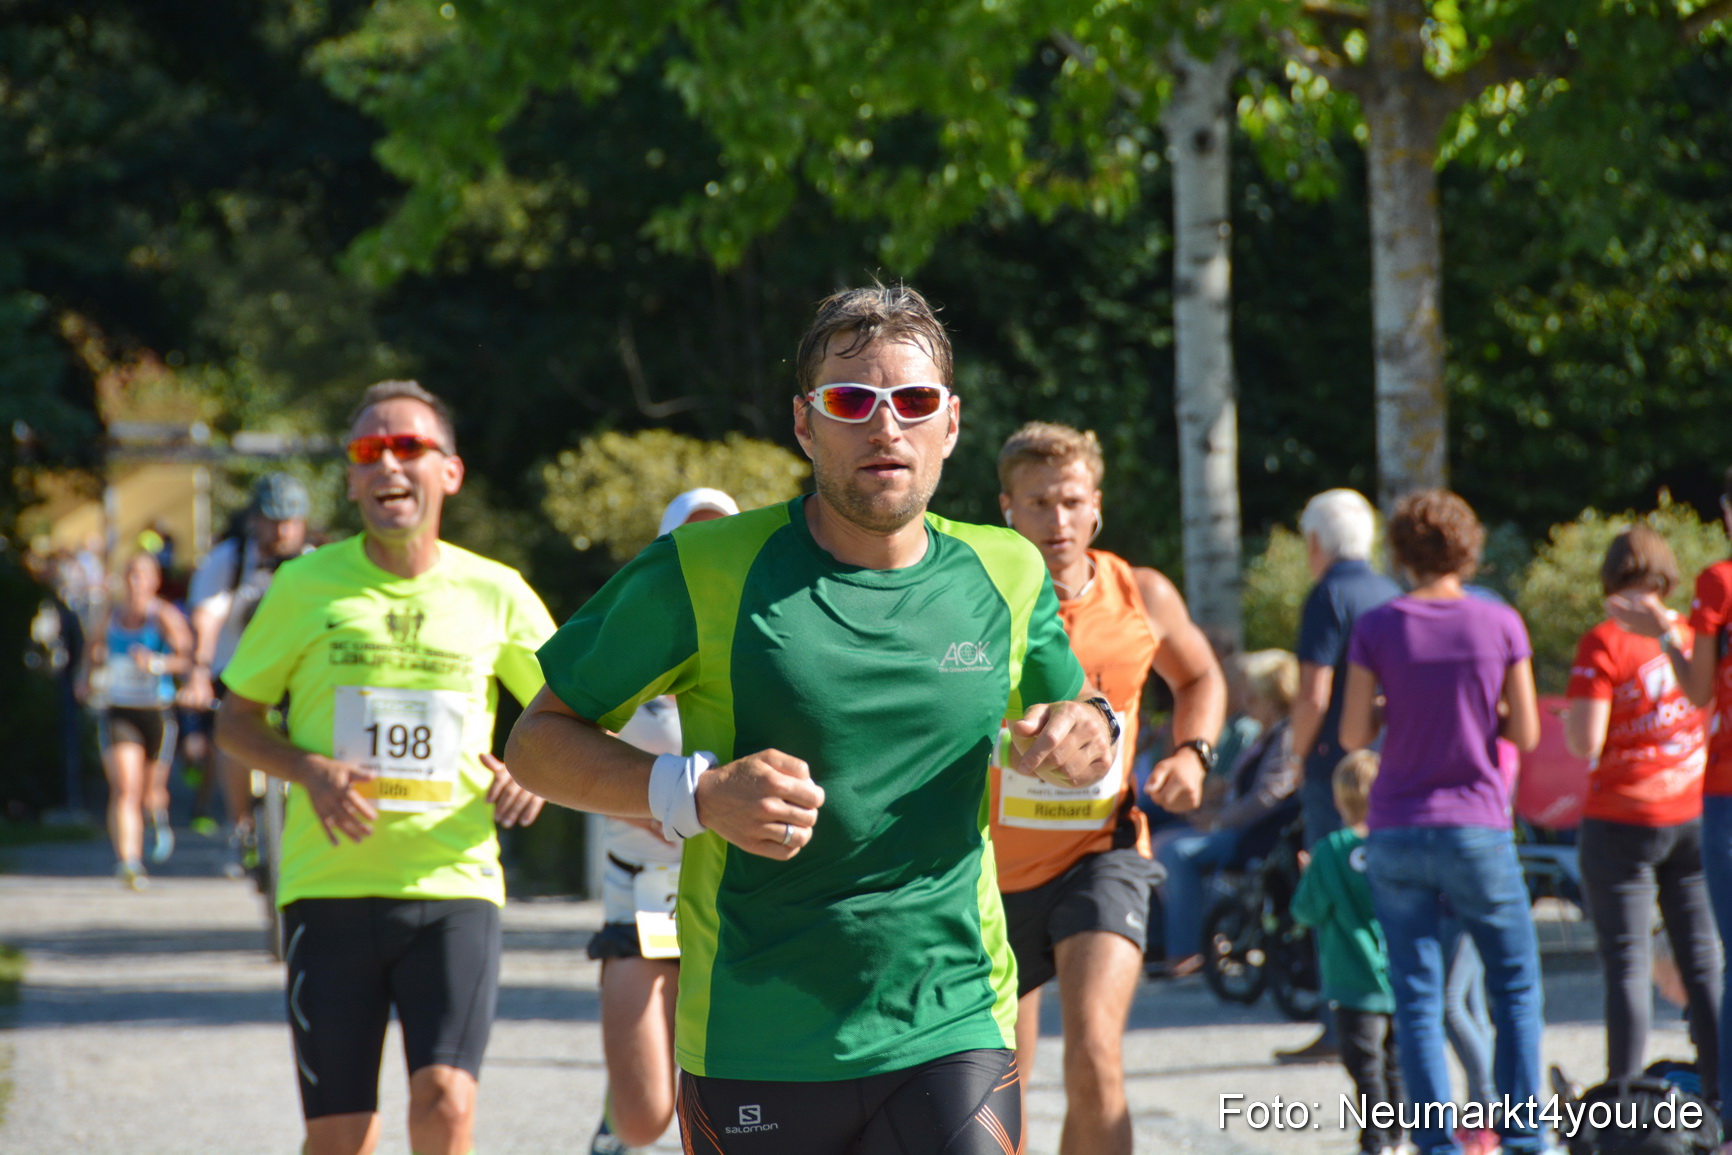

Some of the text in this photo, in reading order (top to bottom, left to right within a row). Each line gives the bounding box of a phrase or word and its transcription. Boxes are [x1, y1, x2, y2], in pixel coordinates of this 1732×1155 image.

[940, 641, 992, 666] AOK
[364, 723, 432, 760] 198
[1034, 803, 1092, 818] Richard
